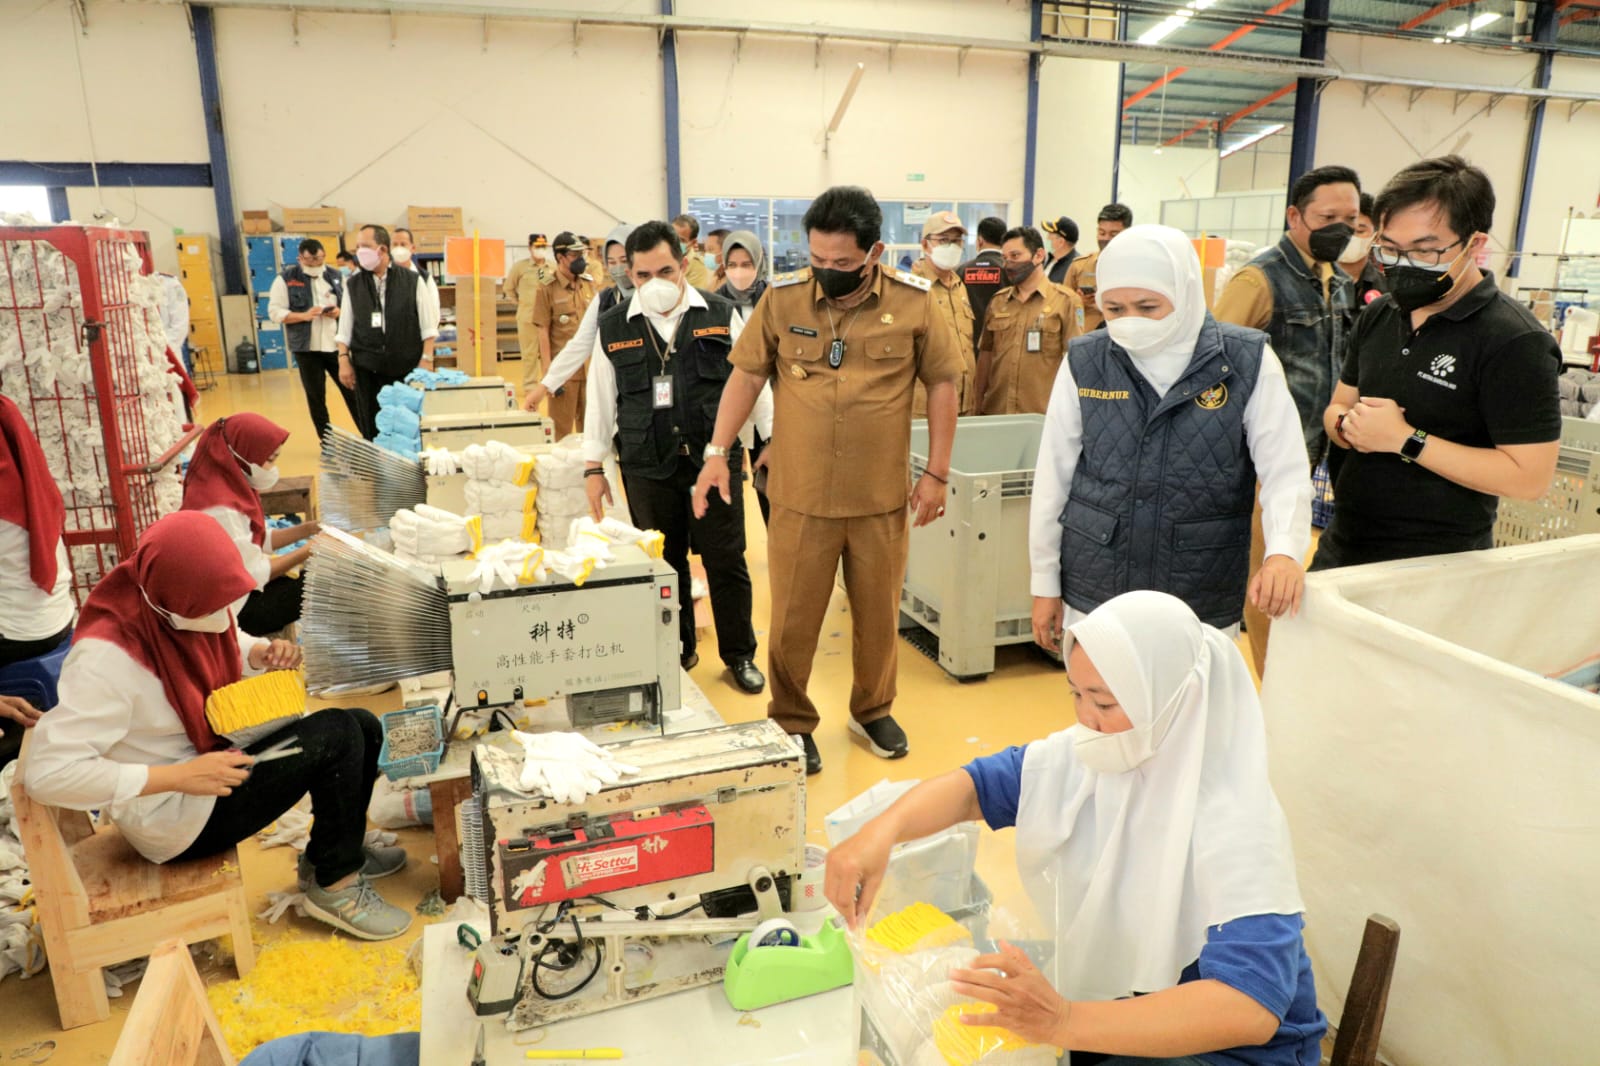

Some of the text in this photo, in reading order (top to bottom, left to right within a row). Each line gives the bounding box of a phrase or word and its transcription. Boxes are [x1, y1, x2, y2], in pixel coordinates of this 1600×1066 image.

[1078, 388, 1129, 400] GUBERNUR
[529, 619, 576, 644] 科特
[496, 642, 625, 669] 高性能手套打包机
[578, 856, 634, 873] Hi-Setter
